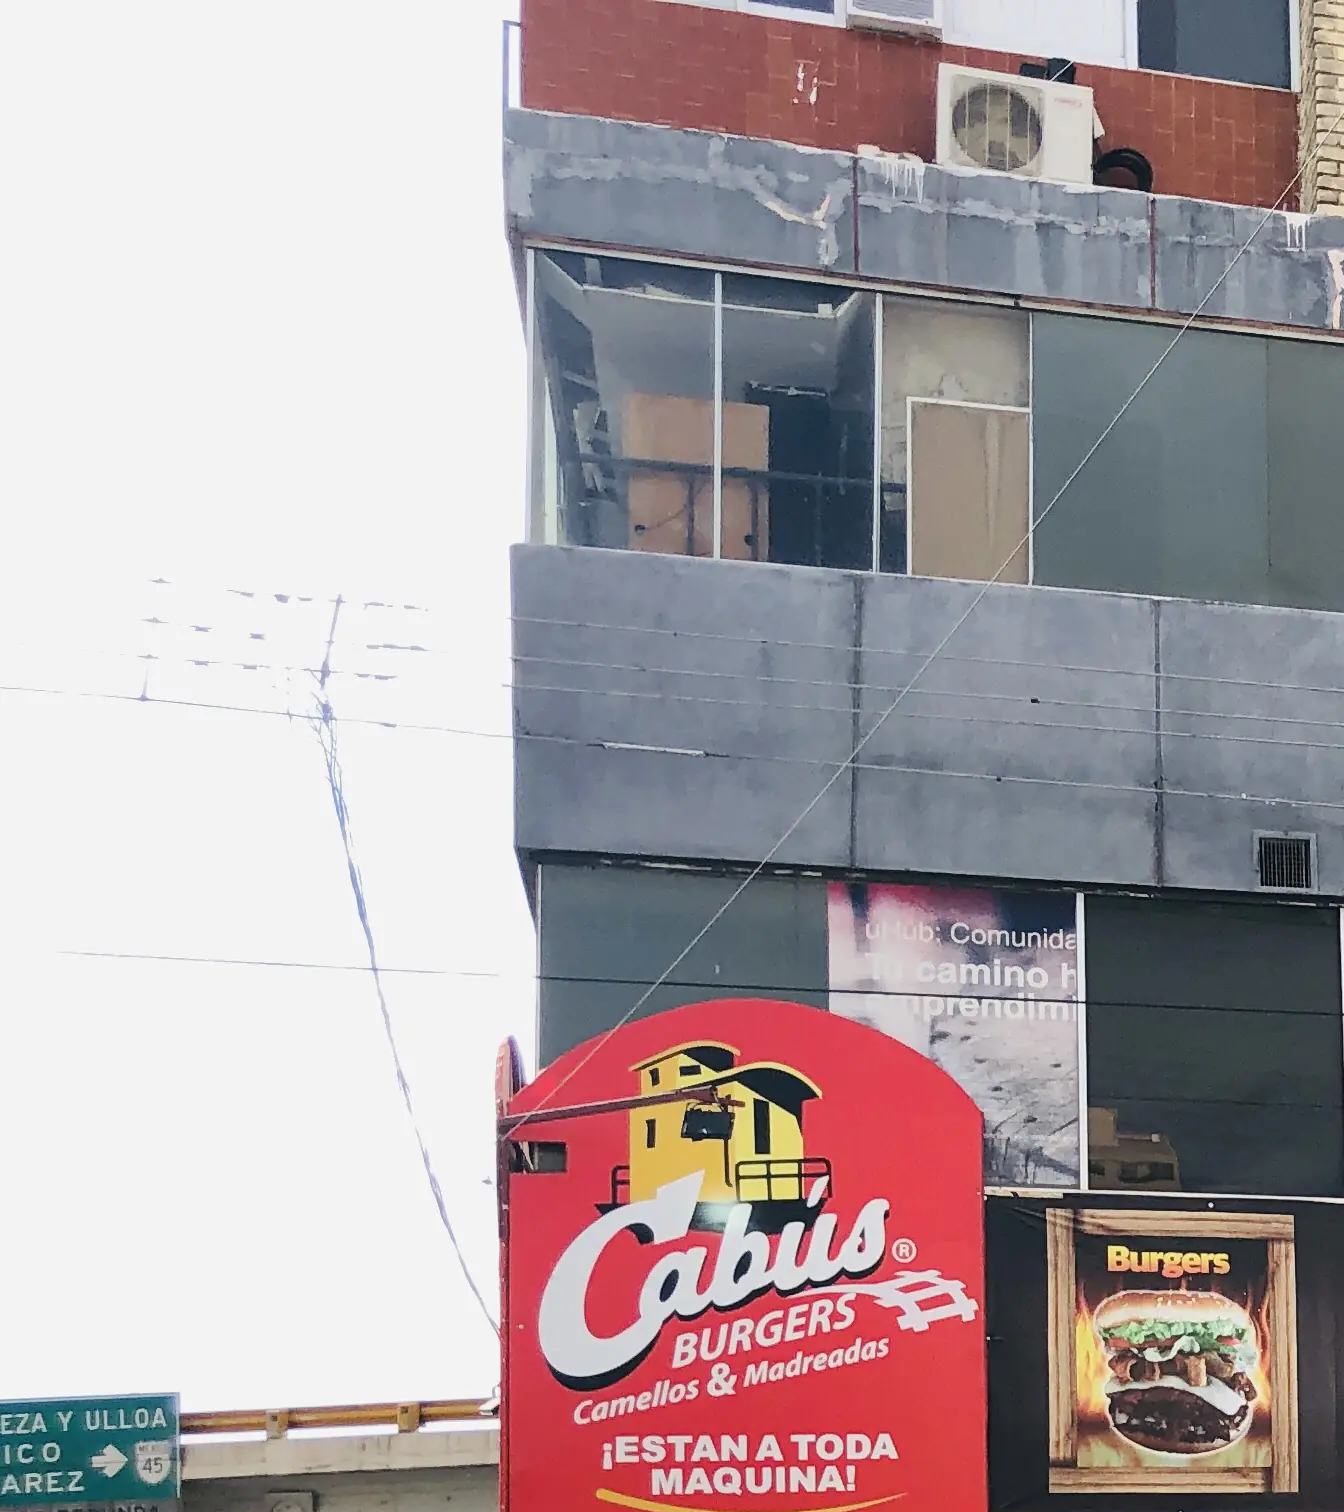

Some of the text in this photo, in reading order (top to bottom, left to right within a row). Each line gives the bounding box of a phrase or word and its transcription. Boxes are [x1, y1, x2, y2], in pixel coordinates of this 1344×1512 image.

[916, 958, 1049, 989] camino
[538, 1170, 890, 1380] Cabús
[1107, 1245, 1231, 1278] Burgers
[672, 1292, 856, 1370] BURGERS
[573, 1337, 891, 1426] Camellos & Madreadas
[0, 1407, 168, 1435] EZA Y ULLOA
[3, 1441, 61, 1465] ICO
[142, 1456, 163, 1474] 45
[602, 1433, 900, 1469] ¡ESTAN A TODA
[0, 1470, 85, 1495] AREZ
[651, 1465, 857, 1497] MAQUINA!
